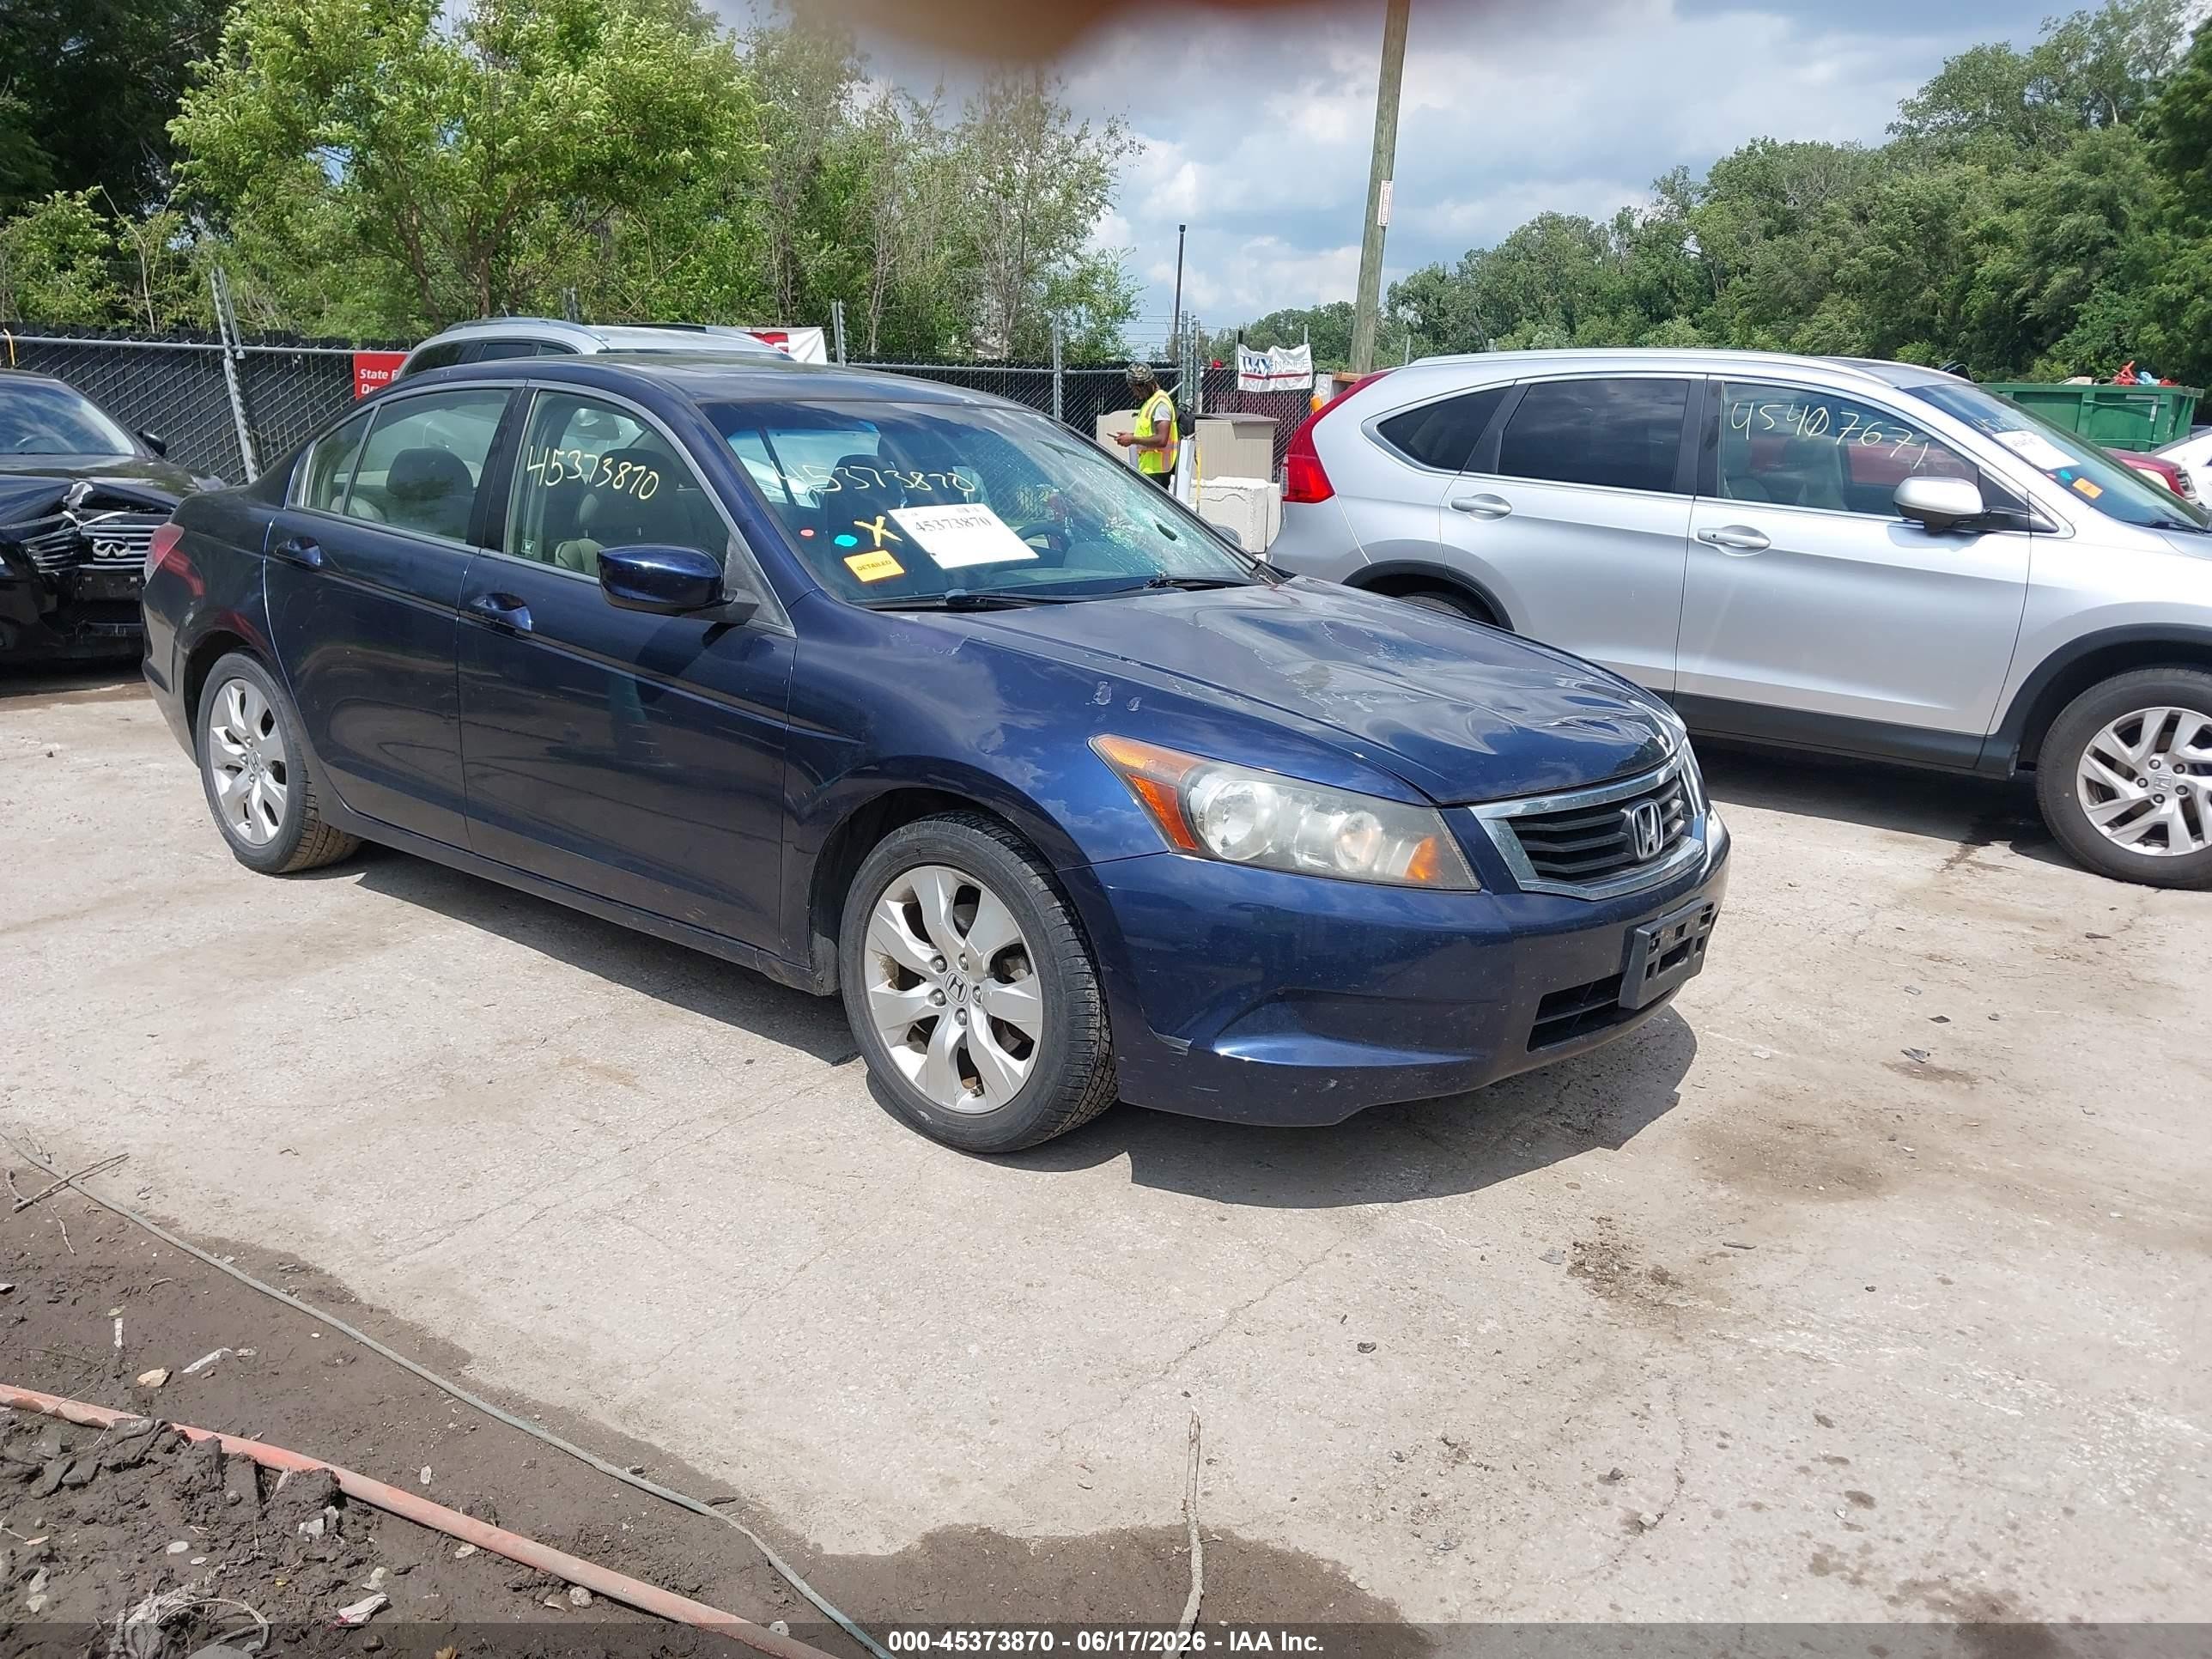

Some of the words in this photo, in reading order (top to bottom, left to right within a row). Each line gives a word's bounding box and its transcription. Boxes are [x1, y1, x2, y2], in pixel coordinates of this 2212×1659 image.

[359, 368, 389, 380] State
[526, 445, 659, 500] 45373870
[770, 460, 976, 493] 45373870
[915, 516, 993, 532] 45373870
